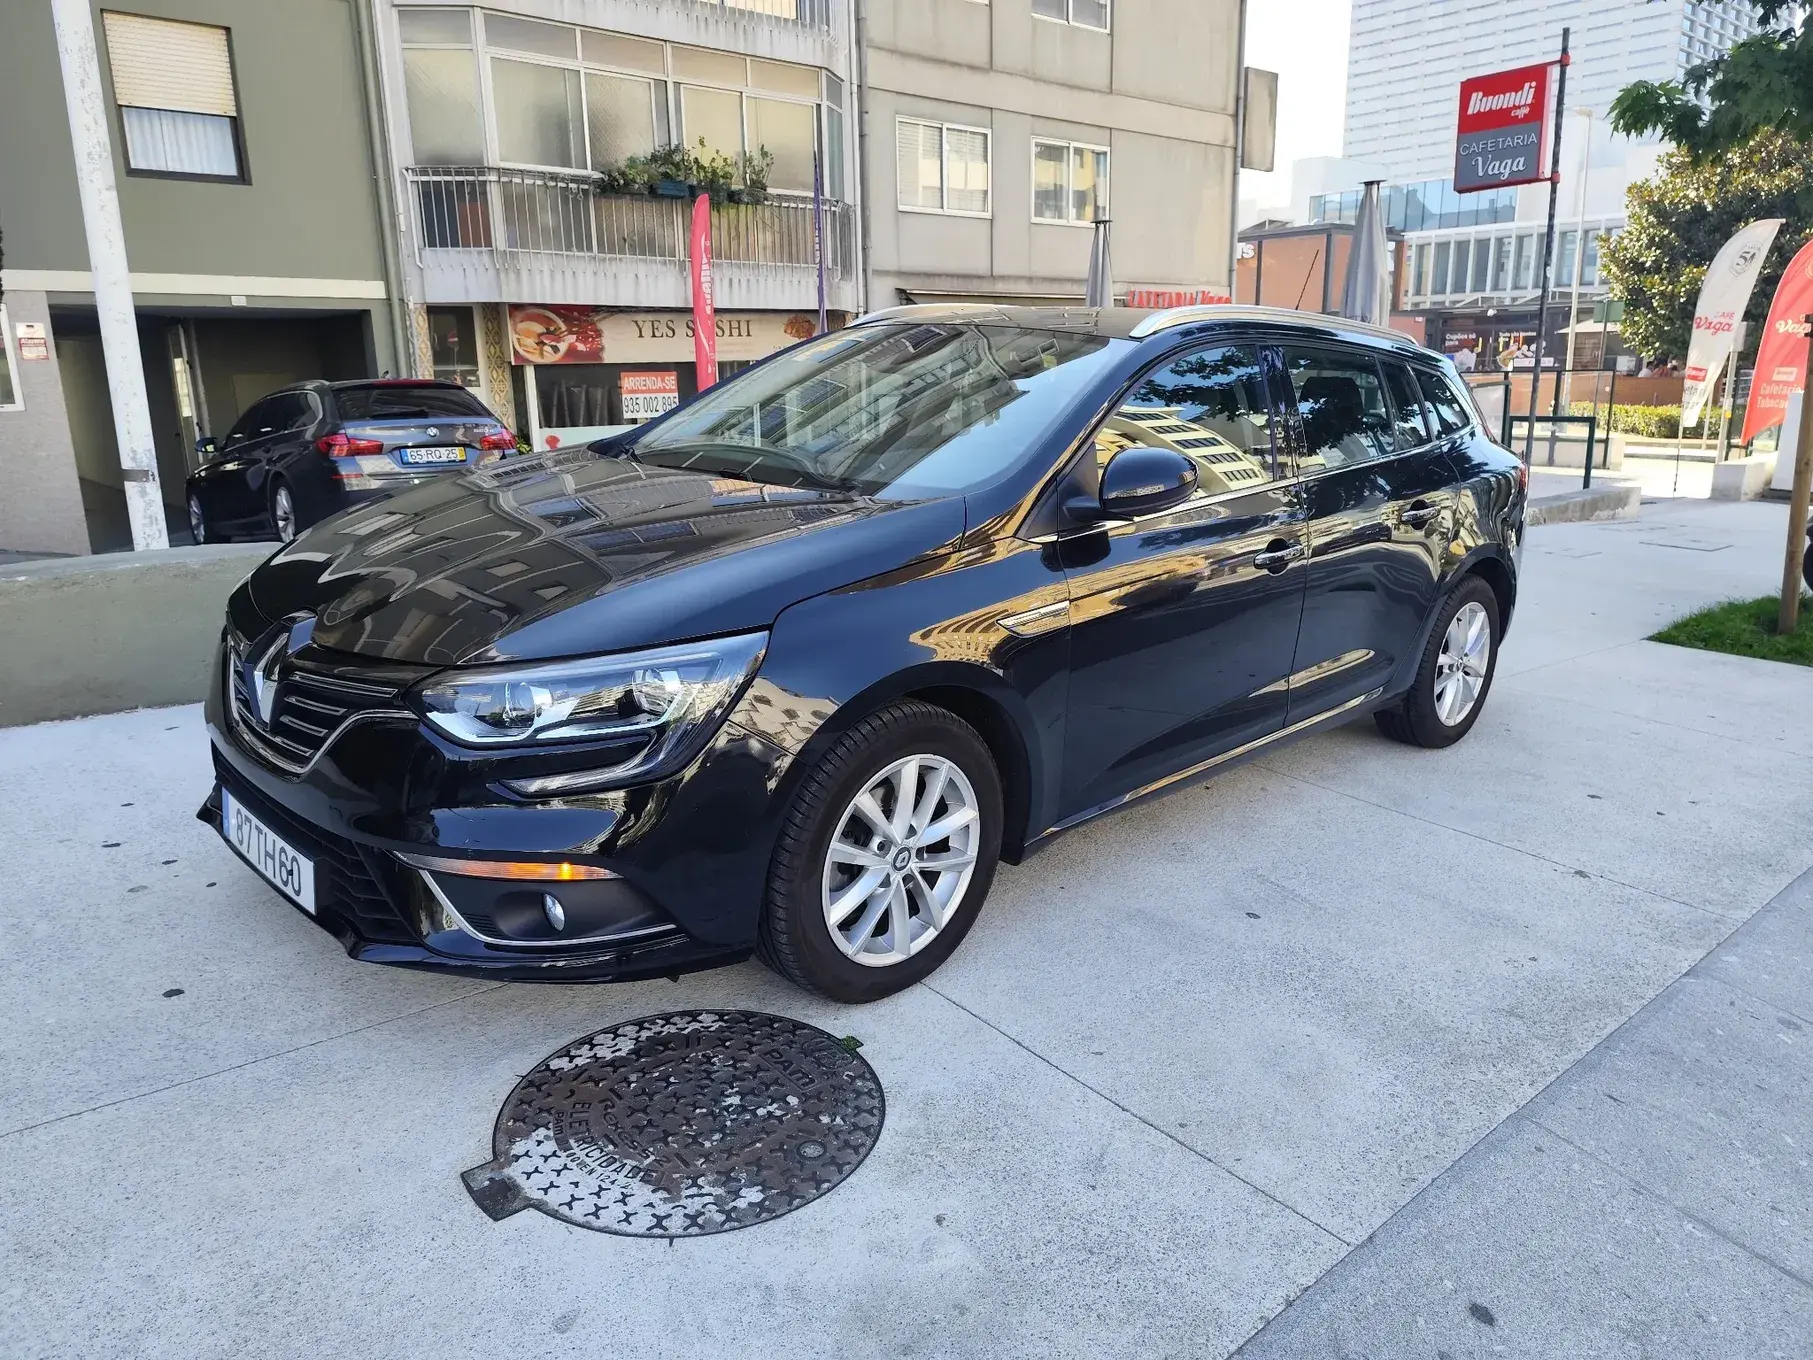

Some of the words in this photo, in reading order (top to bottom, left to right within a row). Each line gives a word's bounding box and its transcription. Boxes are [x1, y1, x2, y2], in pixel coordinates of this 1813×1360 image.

[1467, 81, 1537, 115] Buondi
[1460, 133, 1538, 155] CAFETARIA
[1472, 155, 1527, 180] Vaga
[632, 319, 675, 338] YES
[685, 319, 752, 338] SSHI
[1775, 319, 1811, 338] Vag
[624, 376, 676, 390] ARRENDA-SE
[624, 397, 640, 413] 935
[643, 396, 659, 412] 002
[662, 396, 677, 412] 895
[569, 1102, 658, 1186] ELETRICIDADE
